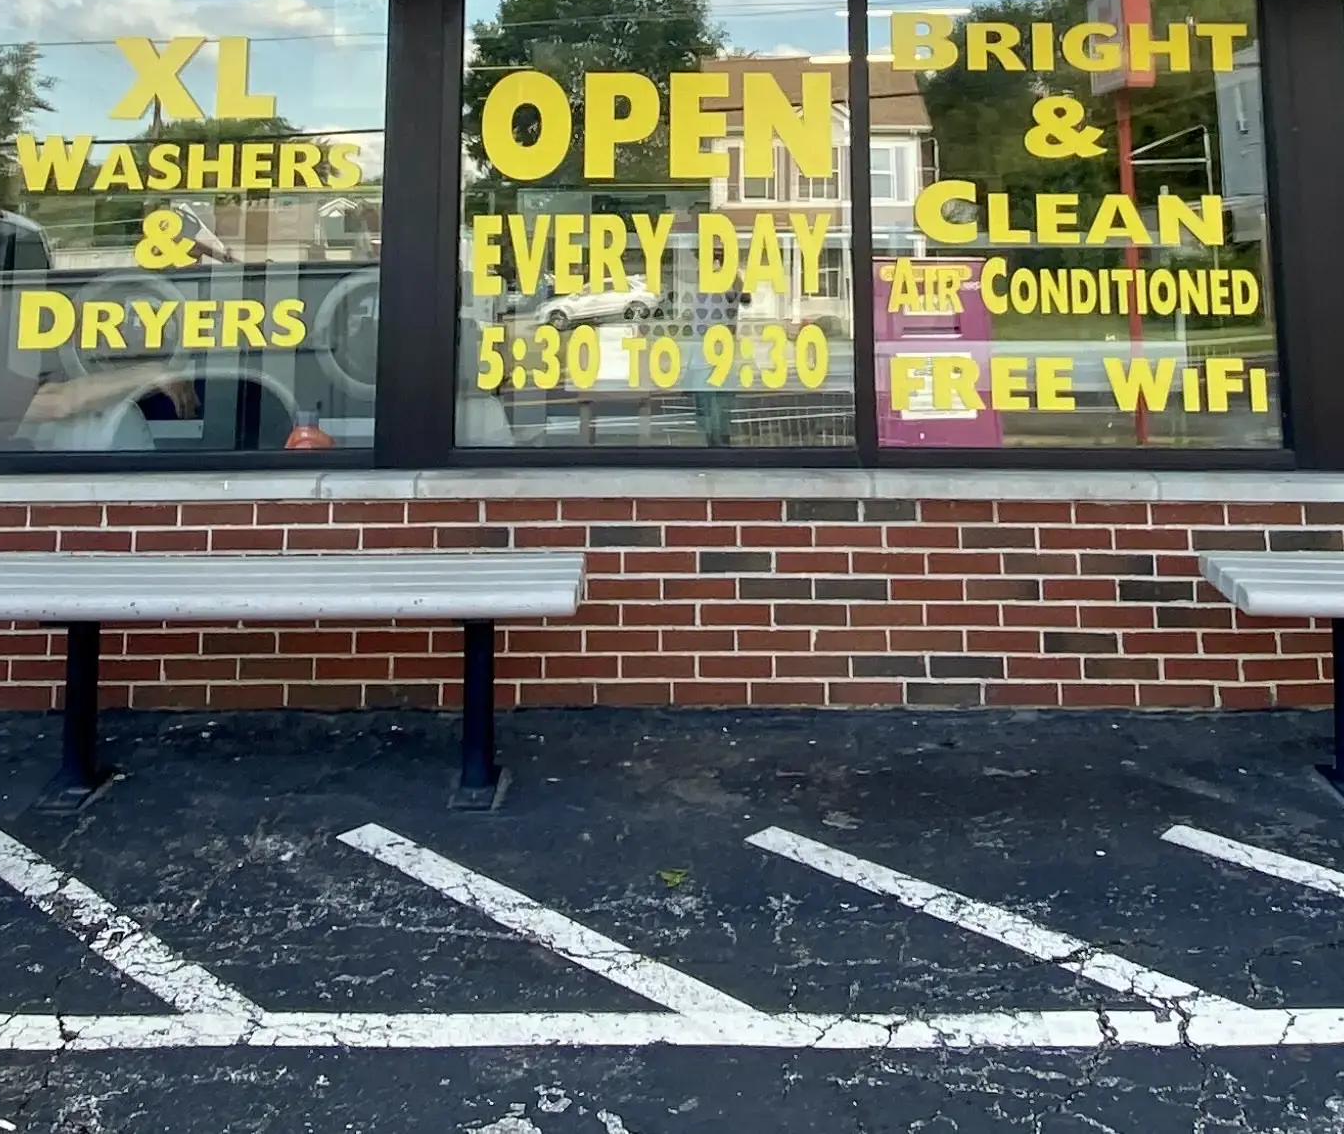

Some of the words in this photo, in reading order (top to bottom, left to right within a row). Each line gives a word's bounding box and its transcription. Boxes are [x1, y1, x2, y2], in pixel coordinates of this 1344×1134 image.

[891, 12, 1248, 72] BRIGHT
[108, 36, 278, 120] XL
[482, 71, 833, 181] OPEN
[1024, 95, 1108, 158] &
[16, 133, 363, 192] WASHERS
[135, 210, 197, 270] &
[915, 180, 1224, 246] CLEAN
[472, 214, 675, 296] EVERY
[698, 214, 832, 295] DAY
[887, 257, 964, 313] AIR
[980, 257, 1260, 315] CONDITIONED
[17, 290, 308, 350] DRYERS
[477, 324, 601, 389] 5:30
[702, 323, 830, 388] 9:30
[889, 357, 1077, 412] FREE
